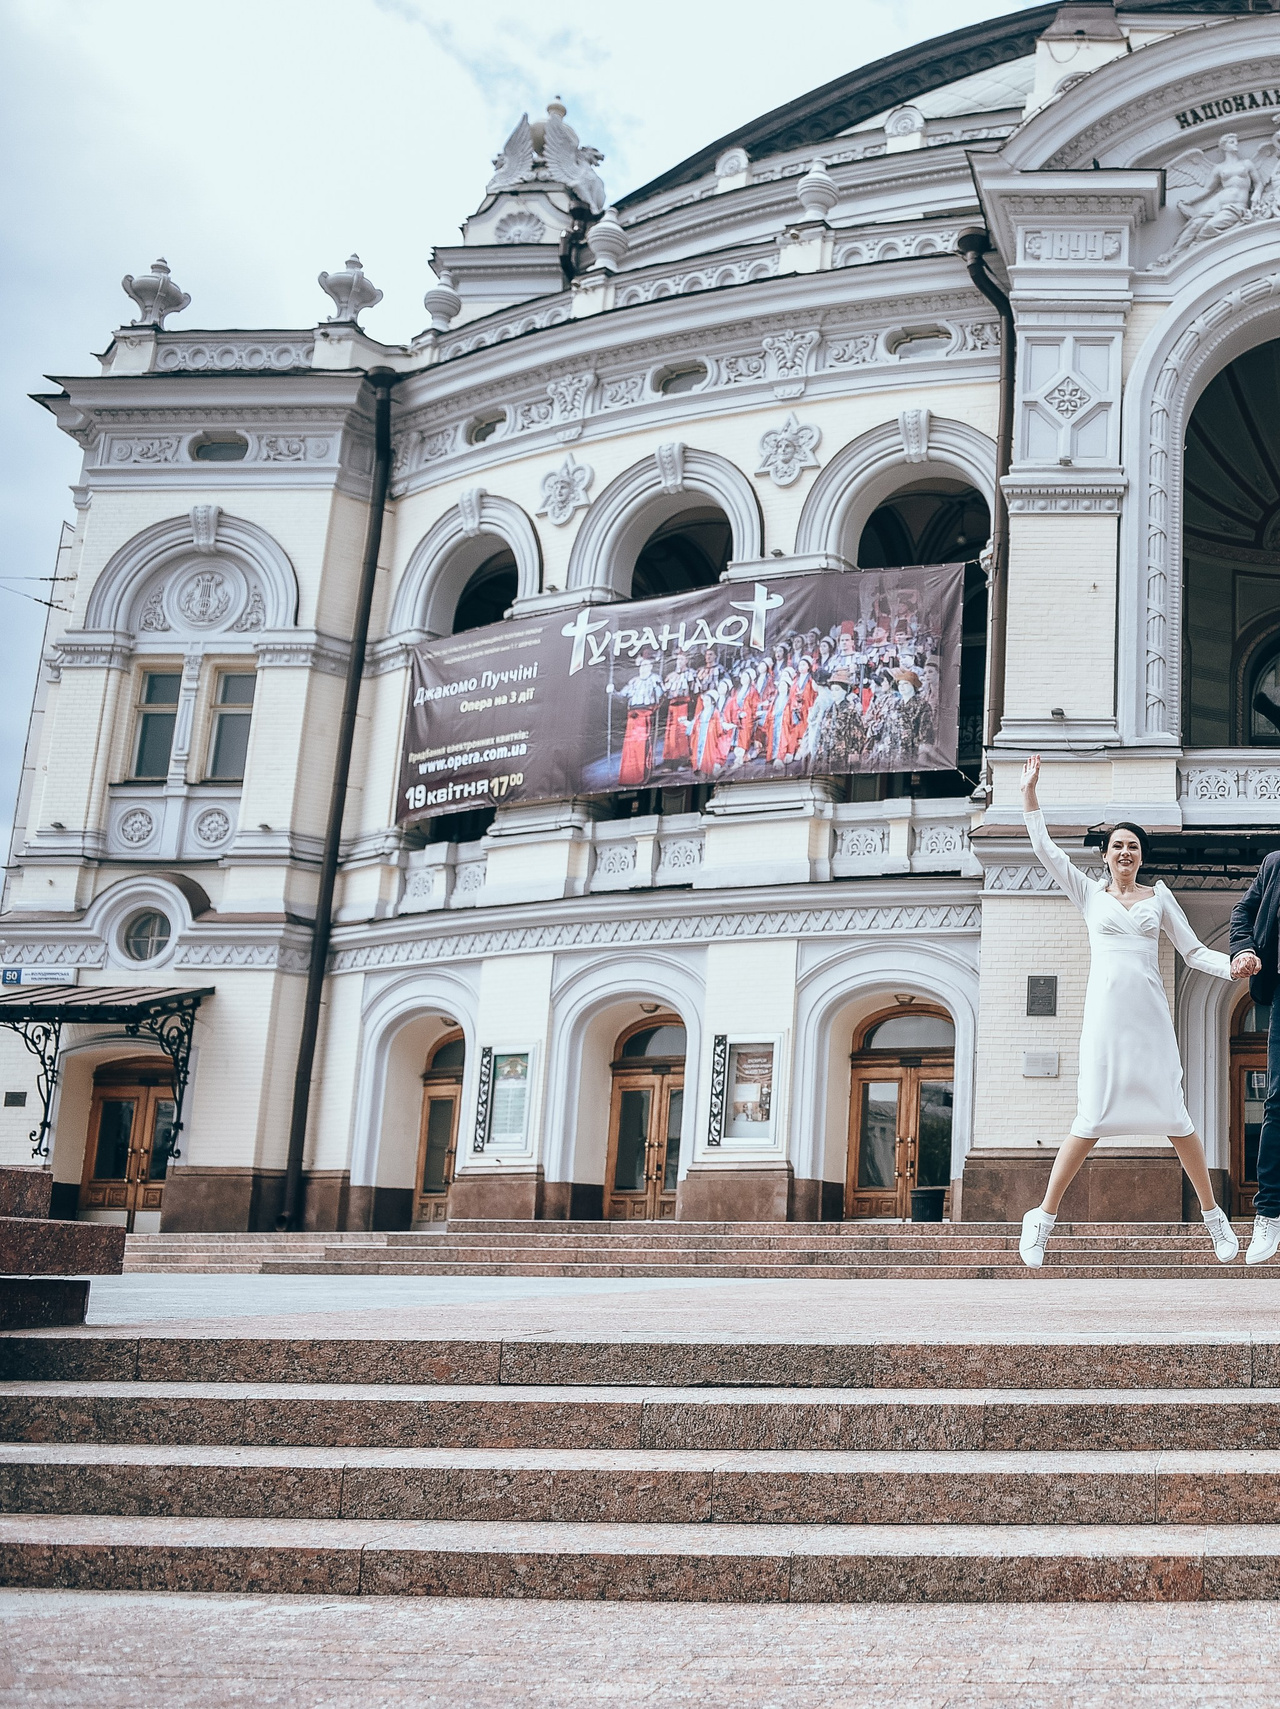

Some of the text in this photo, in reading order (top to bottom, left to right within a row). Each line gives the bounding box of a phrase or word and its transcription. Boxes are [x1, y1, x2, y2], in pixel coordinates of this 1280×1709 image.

[561, 582, 785, 676] ТУРАНДОТ
[413, 661, 539, 707] Джакомо Пуччіні
[459, 687, 536, 713] Опера на 3 дії
[418, 743, 528, 775] www.opera.com.ua
[405, 784, 427, 810] 19
[5, 970, 18, 981] 50
